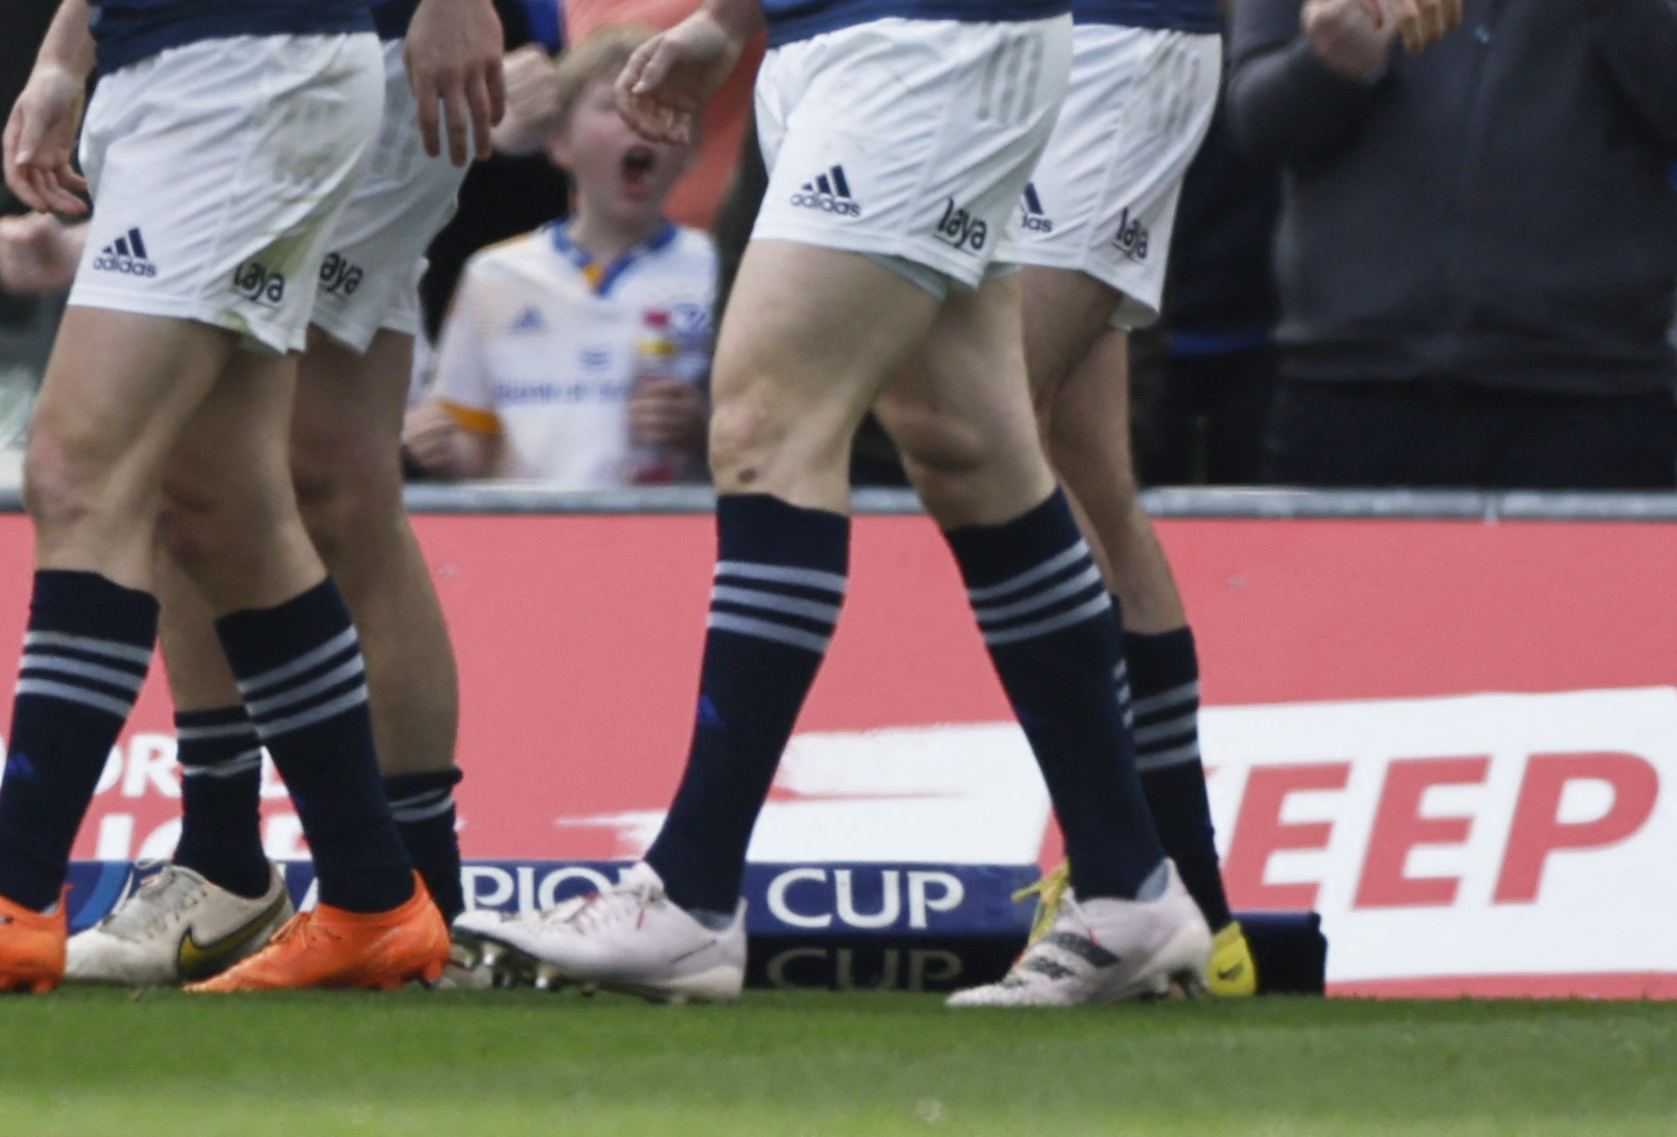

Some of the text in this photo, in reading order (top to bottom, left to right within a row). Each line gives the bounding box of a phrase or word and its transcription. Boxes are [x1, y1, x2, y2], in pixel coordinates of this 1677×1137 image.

[790, 193, 861, 218] adidas
[936, 197, 987, 251] laya
[93, 254, 158, 278] adidas
[319, 251, 364, 295] aya
[1035, 750, 1661, 912] EEP
[766, 867, 965, 928] CUP
